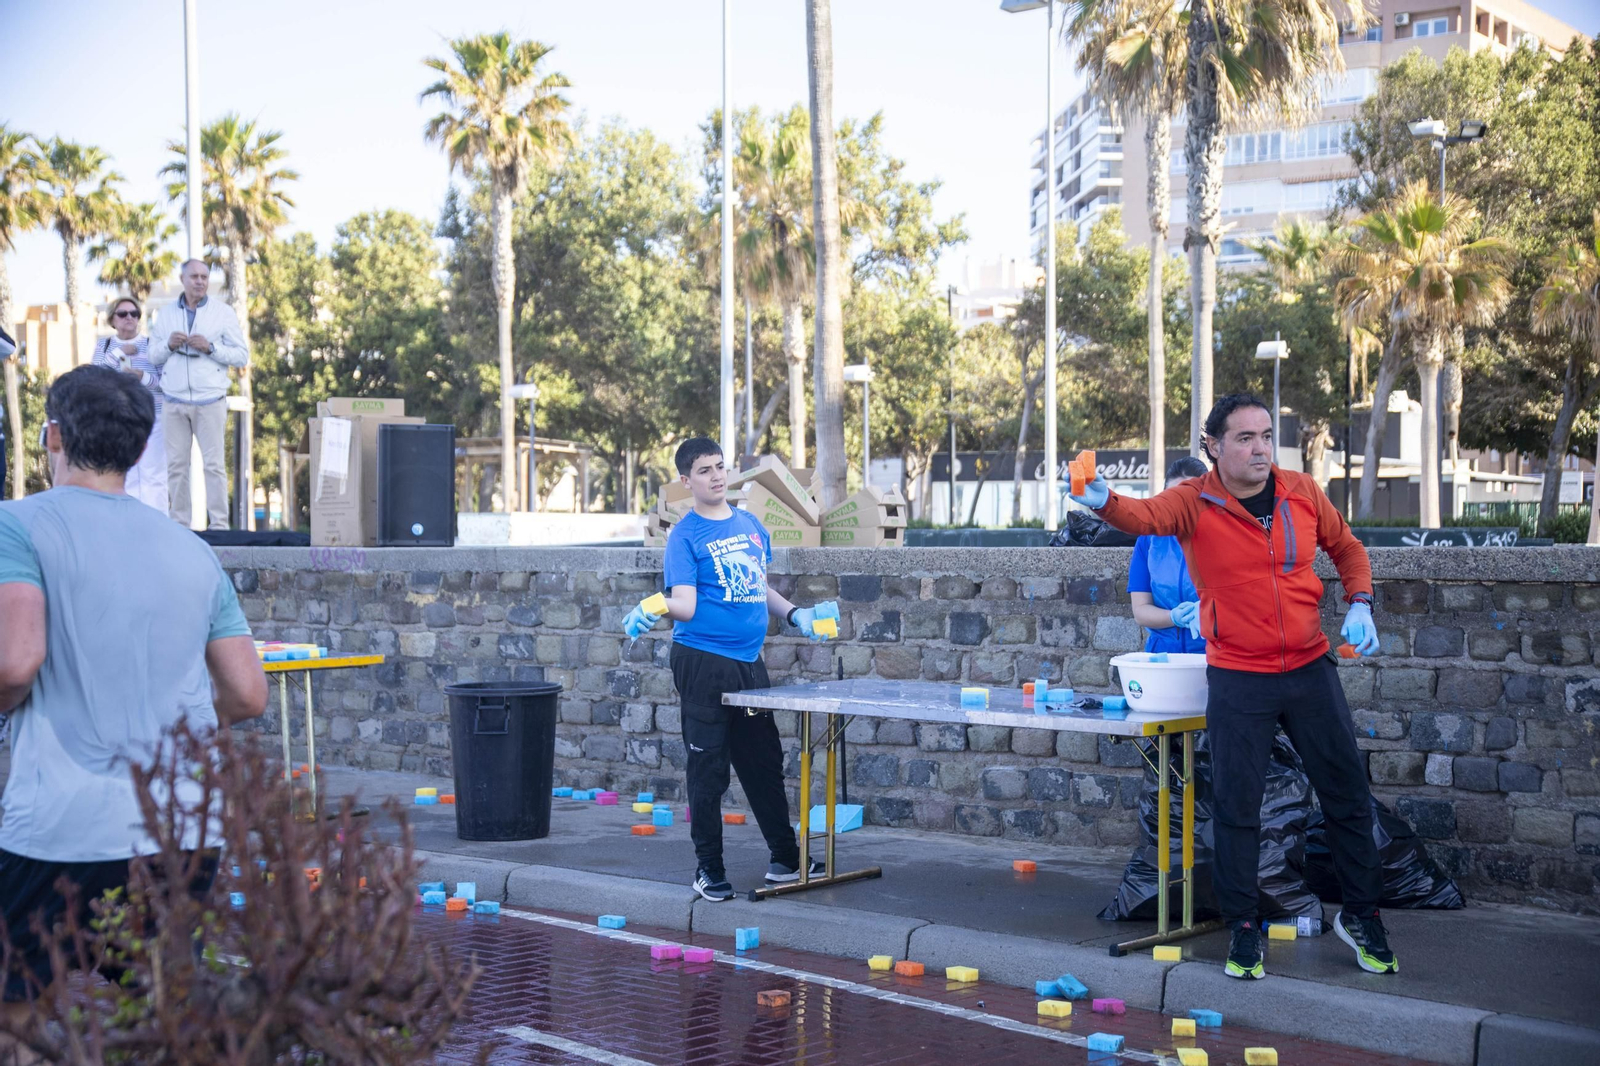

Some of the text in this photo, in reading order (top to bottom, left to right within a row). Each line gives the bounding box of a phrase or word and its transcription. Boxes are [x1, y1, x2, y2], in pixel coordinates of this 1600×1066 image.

[355, 401, 381, 409] SAYMA
[775, 530, 800, 540] SAYMA
[824, 532, 851, 541] SAYMA
[706, 541, 718, 553] IV
[716, 535, 739, 548] Carrera
